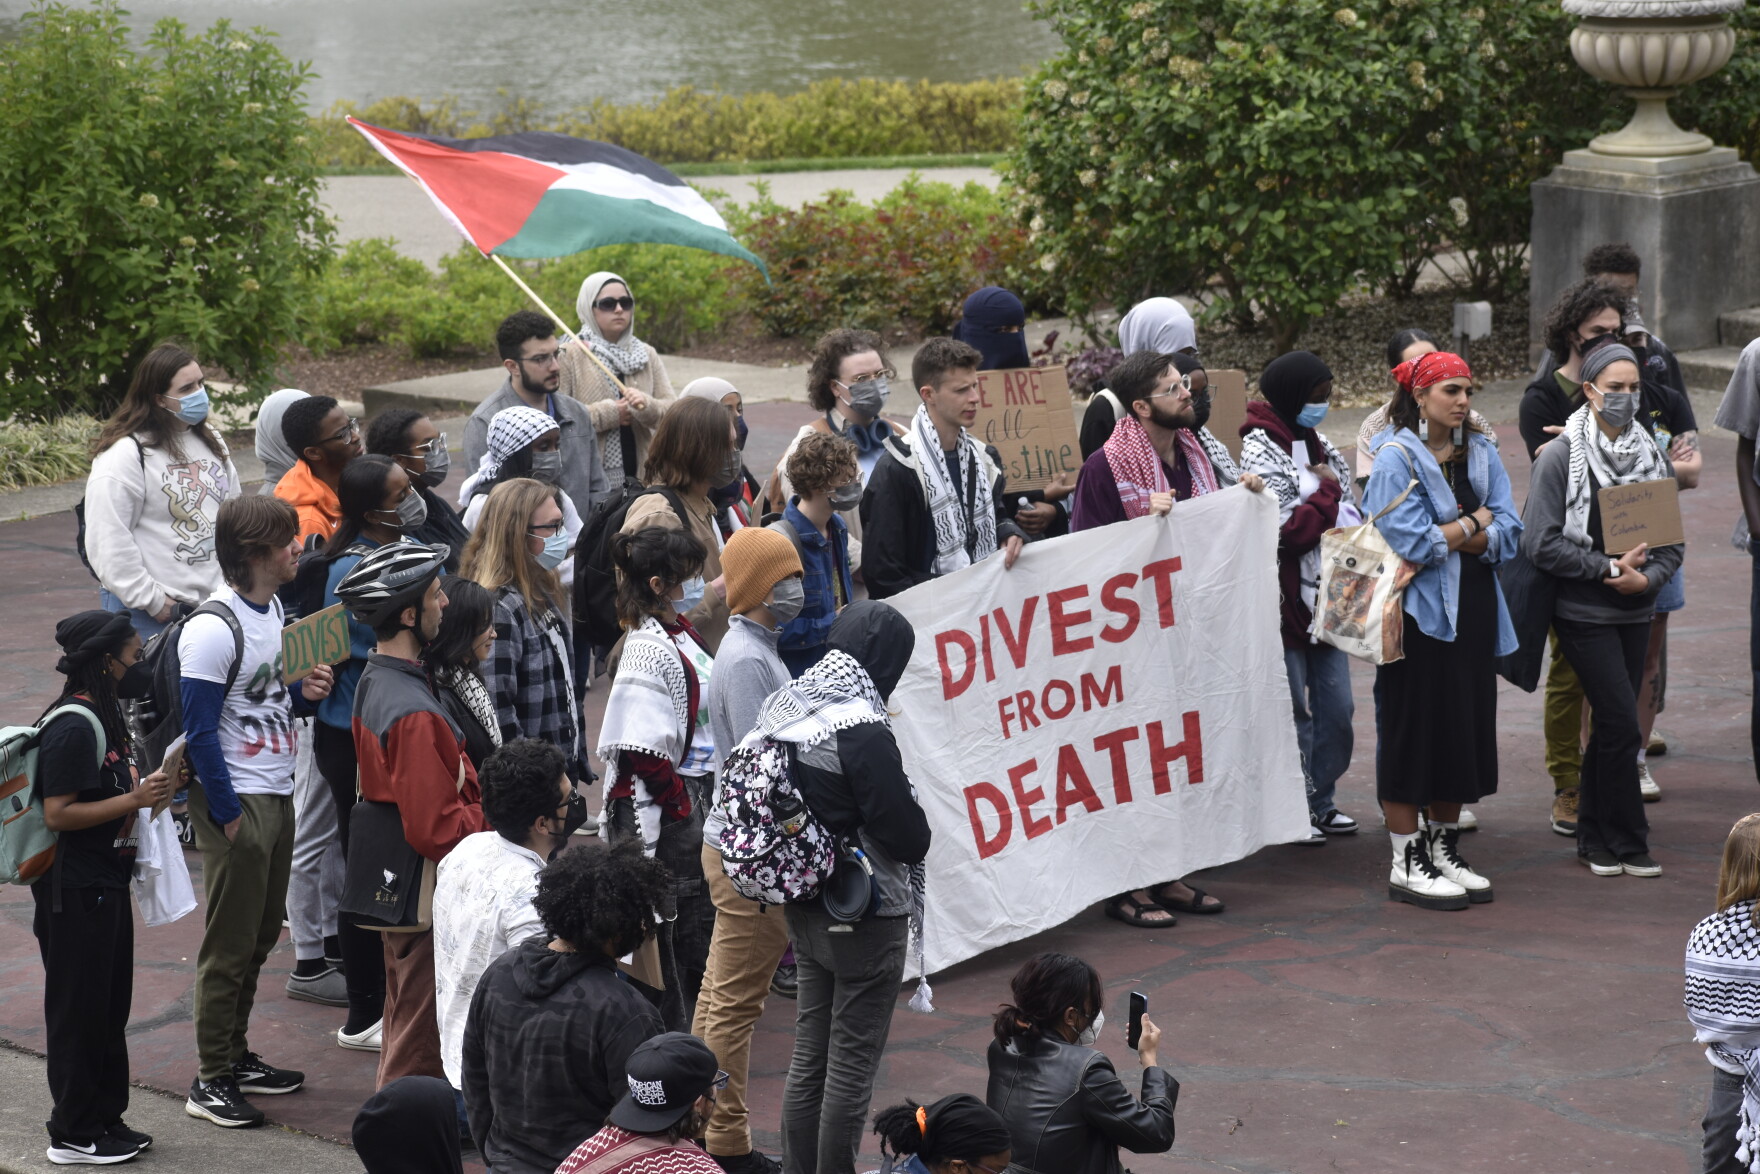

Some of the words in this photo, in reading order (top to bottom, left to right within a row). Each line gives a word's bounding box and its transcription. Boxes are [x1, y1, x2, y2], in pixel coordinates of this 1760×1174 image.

[977, 375, 993, 408] E
[1003, 370, 1047, 406] ARE
[986, 408, 1040, 443] all
[1000, 444, 1076, 481] estine
[1606, 487, 1653, 510] Solidarity
[284, 608, 350, 675] DIVEST
[934, 555, 1182, 701] DIVEST
[997, 664, 1124, 739] FROM
[963, 710, 1204, 860] DEATH
